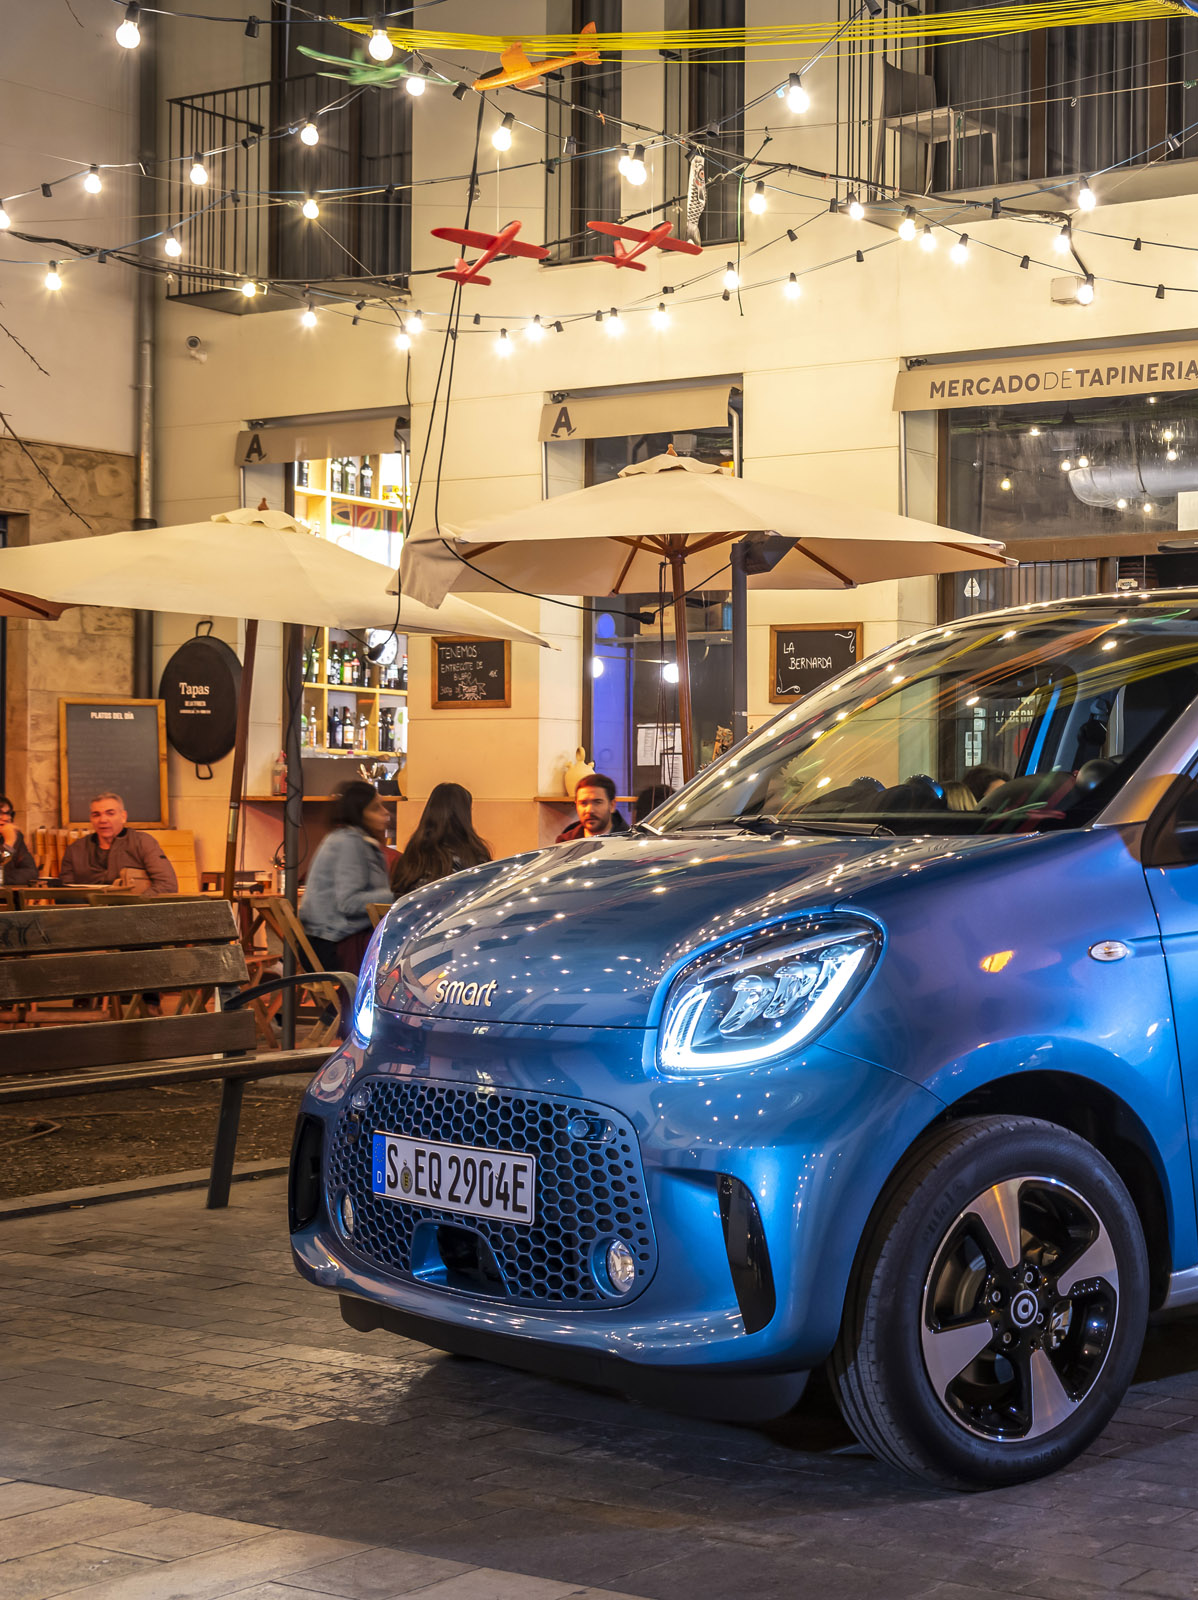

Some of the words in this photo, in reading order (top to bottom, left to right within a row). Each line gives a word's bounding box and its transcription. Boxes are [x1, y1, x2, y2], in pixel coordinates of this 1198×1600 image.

[929, 373, 1041, 399] MERCADO
[439, 645, 477, 659] TENEMOS
[783, 642, 795, 654] LA
[788, 656, 833, 670] BERNARDA
[179, 682, 210, 698] Tapas
[433, 979, 498, 1007] smart
[377, 1171, 382, 1183] D
[387, 1144, 398, 1189] S
[414, 1148, 442, 1200] EQ
[448, 1155, 528, 1215] 2904E
